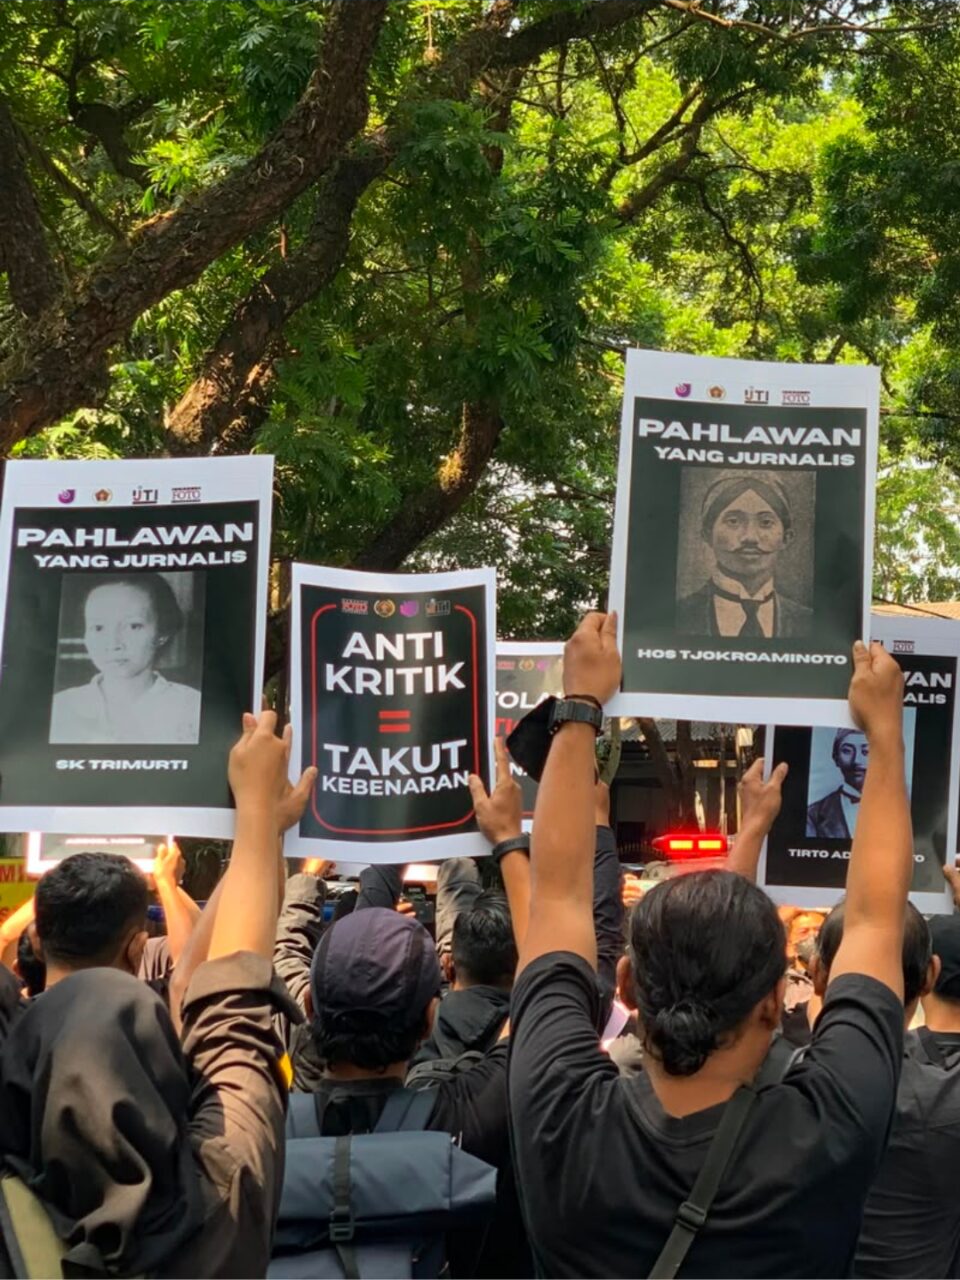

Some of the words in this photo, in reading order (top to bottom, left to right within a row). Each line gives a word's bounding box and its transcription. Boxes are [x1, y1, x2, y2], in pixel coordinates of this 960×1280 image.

[638, 418, 861, 446] PAHLAWAN
[654, 446, 724, 463] YANG
[728, 451, 856, 467] JURNALIS
[17, 522, 254, 547] PAHLAWAN
[34, 554, 109, 568] YANG
[113, 550, 248, 568] JURNALIS
[342, 631, 444, 661] ANTI
[638, 649, 677, 659] HOS
[679, 649, 848, 665] TJOKROAMINOTO
[325, 661, 466, 696] KRITIK
[904, 692, 947, 705] ALIS
[56, 759, 85, 770] SK
[88, 760, 188, 770] TRIMURTI
[323, 739, 467, 776] TAKUT
[322, 770, 469, 796] KEBENARAN
[788, 848, 829, 859] TIRTO
[830, 849, 852, 859] AD
